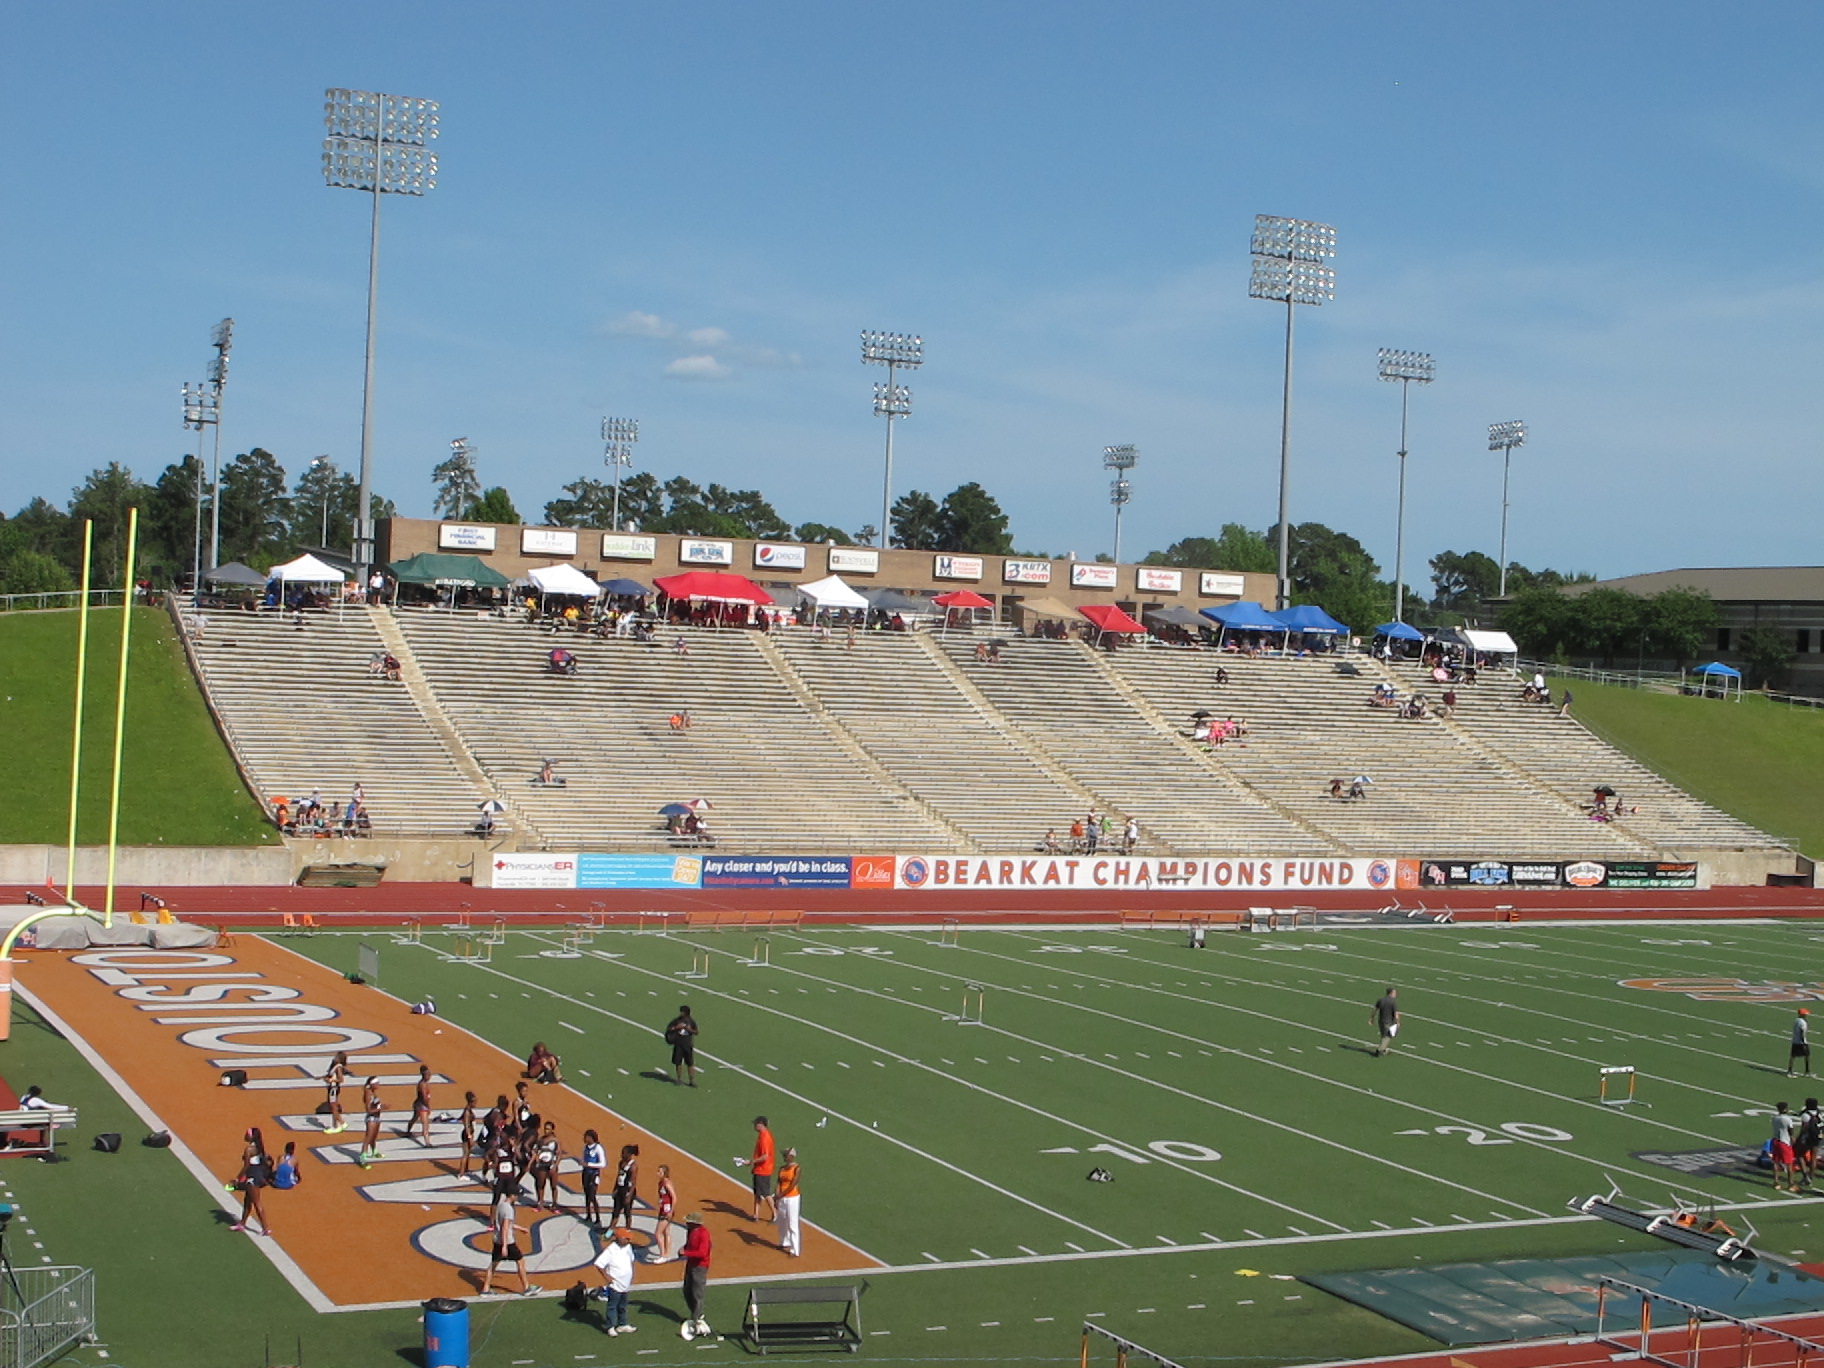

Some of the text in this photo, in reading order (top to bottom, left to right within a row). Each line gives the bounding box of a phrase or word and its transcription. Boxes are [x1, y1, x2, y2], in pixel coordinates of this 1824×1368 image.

[704, 859, 723, 875] Any
[724, 859, 753, 873] closer
[755, 859, 772, 873] and
[773, 859, 798, 875] you'd
[799, 859, 810, 873] be
[811, 859, 821, 873] in
[822, 859, 849, 873] class.
[934, 859, 1355, 886] BEARKAT CHAMPIONS FUND
[67, 948, 456, 1091] HOUSTO
[1434, 1121, 1574, 1145] 20
[1087, 1139, 1223, 1165] 10
